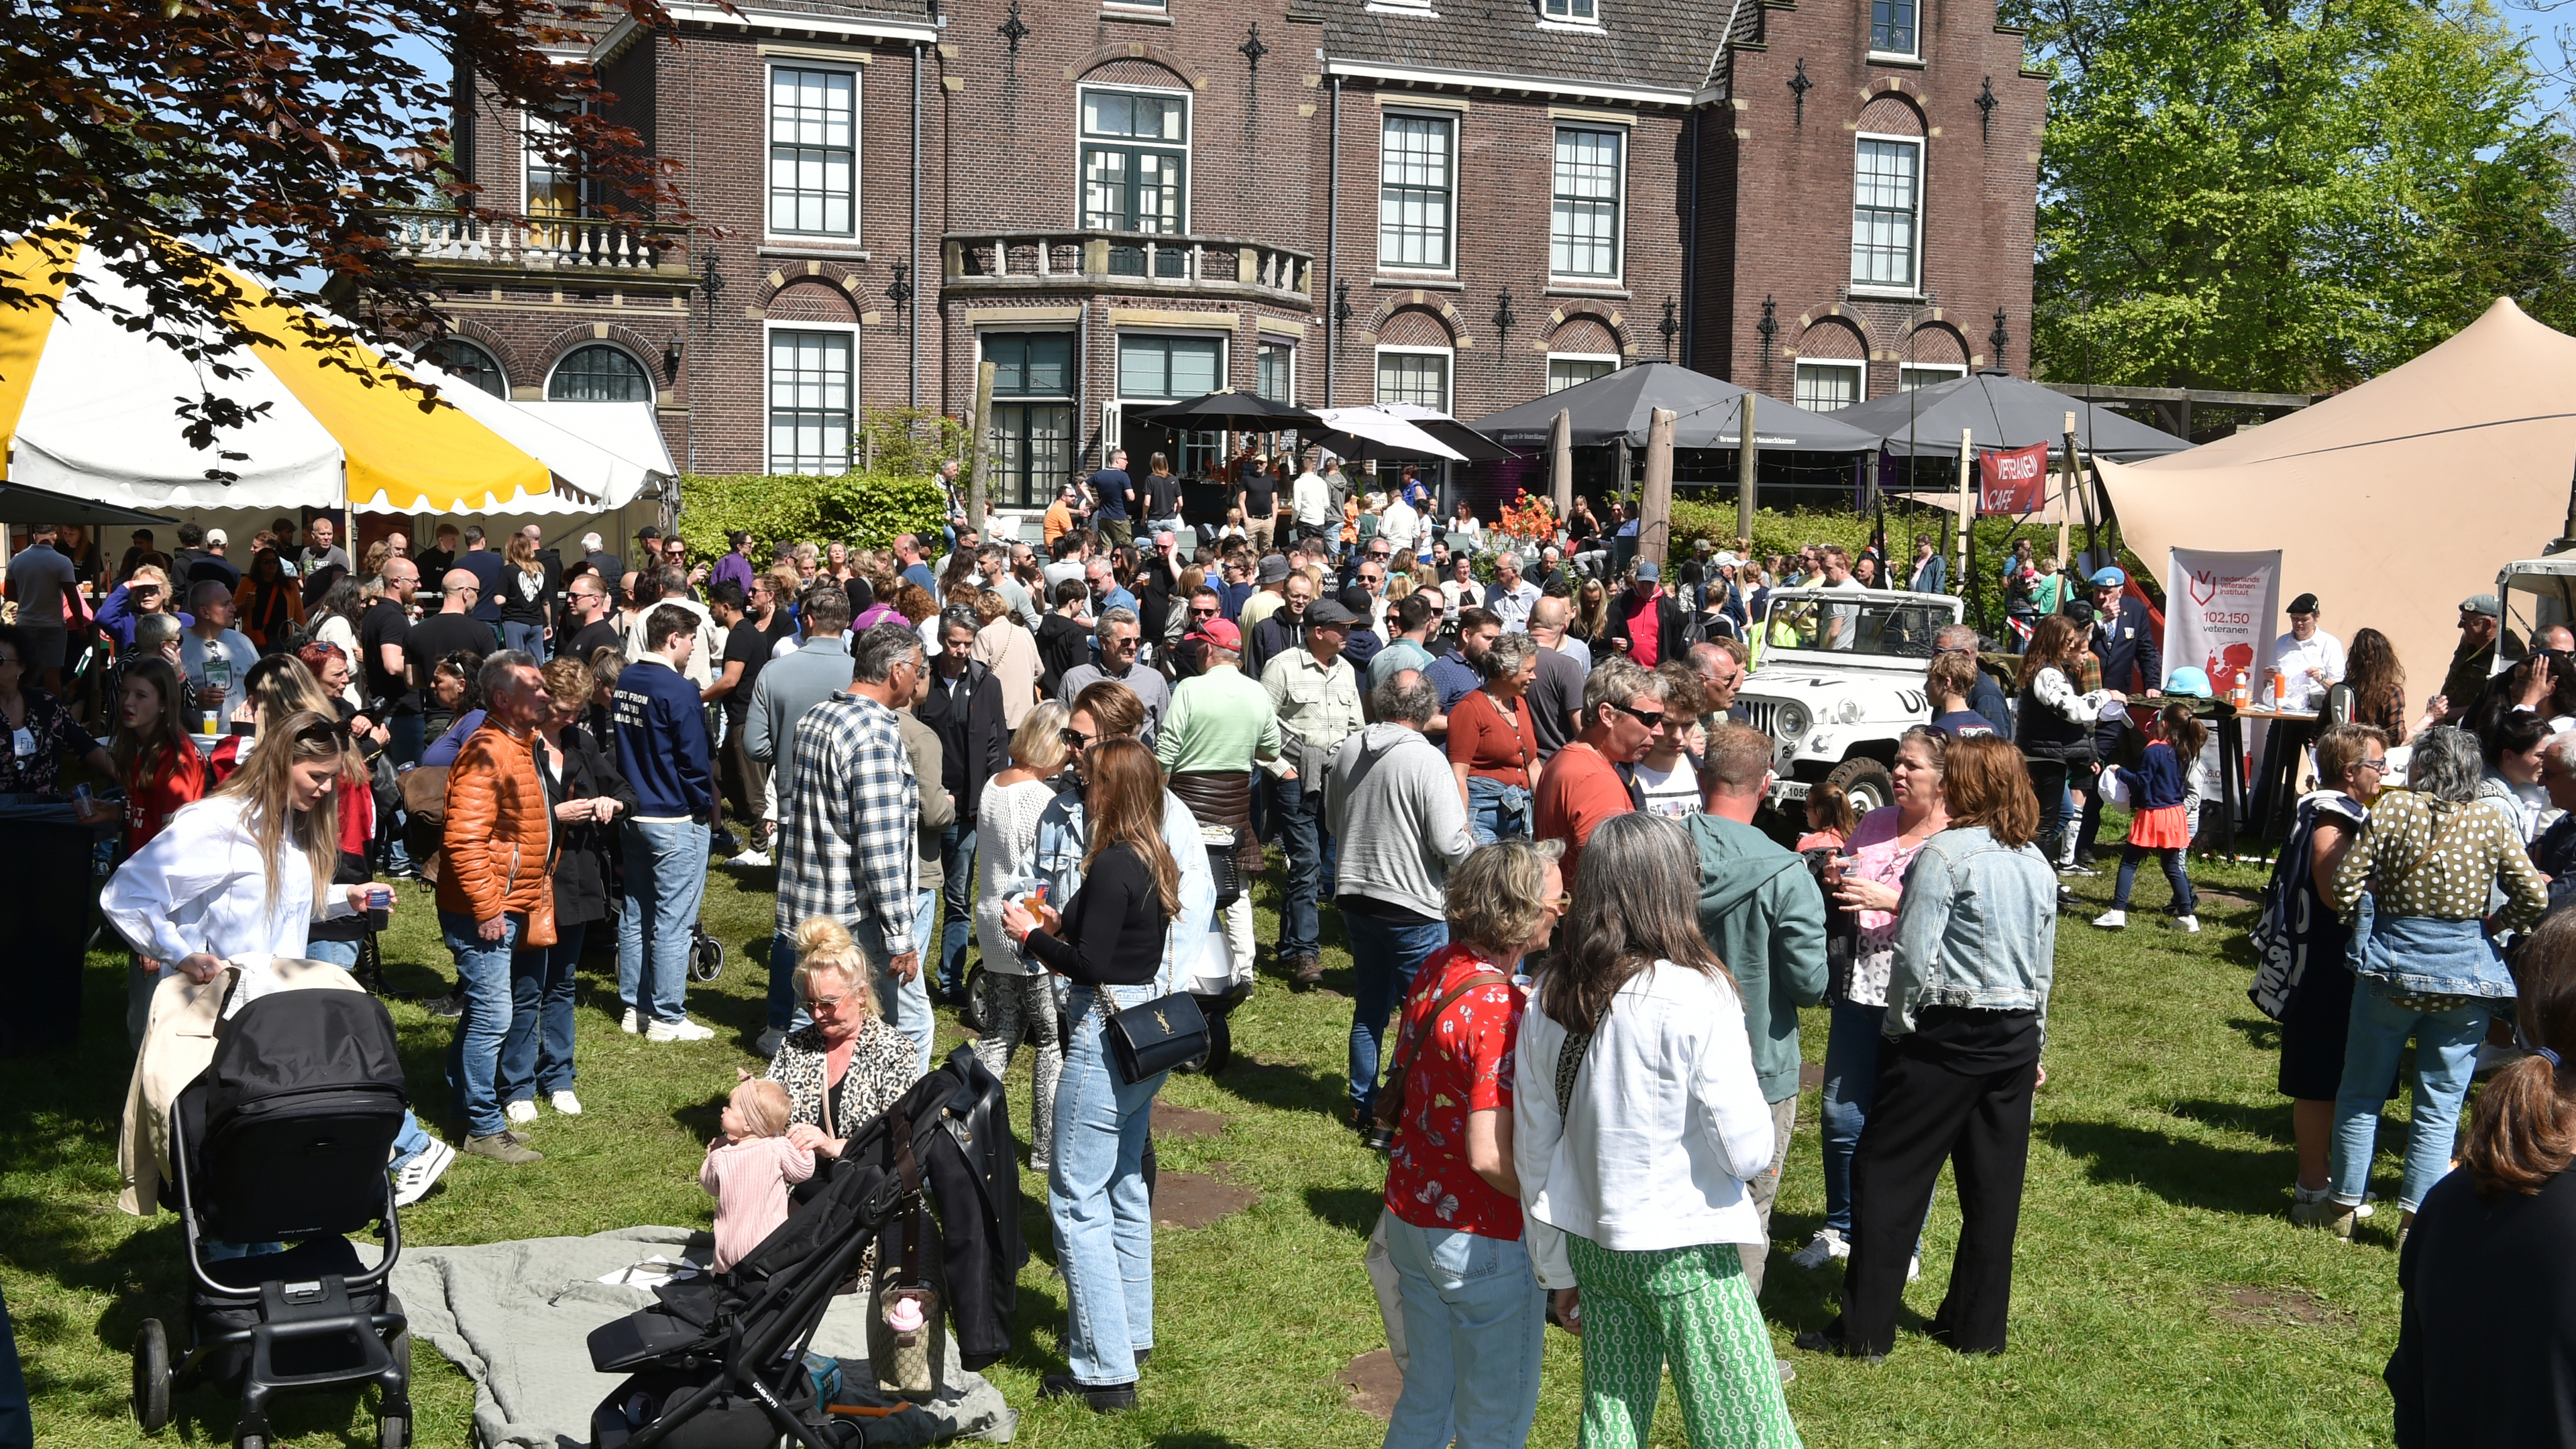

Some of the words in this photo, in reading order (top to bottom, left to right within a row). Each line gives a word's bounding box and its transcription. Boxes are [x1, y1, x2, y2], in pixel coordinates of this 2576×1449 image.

[1988, 484, 2017, 511] CAFÉ
[2203, 611, 2250, 624] 102.150
[2203, 625, 2249, 634] veteranen
[613, 690, 628, 700] NOT
[629, 692, 649, 705] FROM
[620, 702, 639, 715] PARIS
[614, 713, 643, 728] MADME
[753, 1381, 778, 1409] DUBATTI
